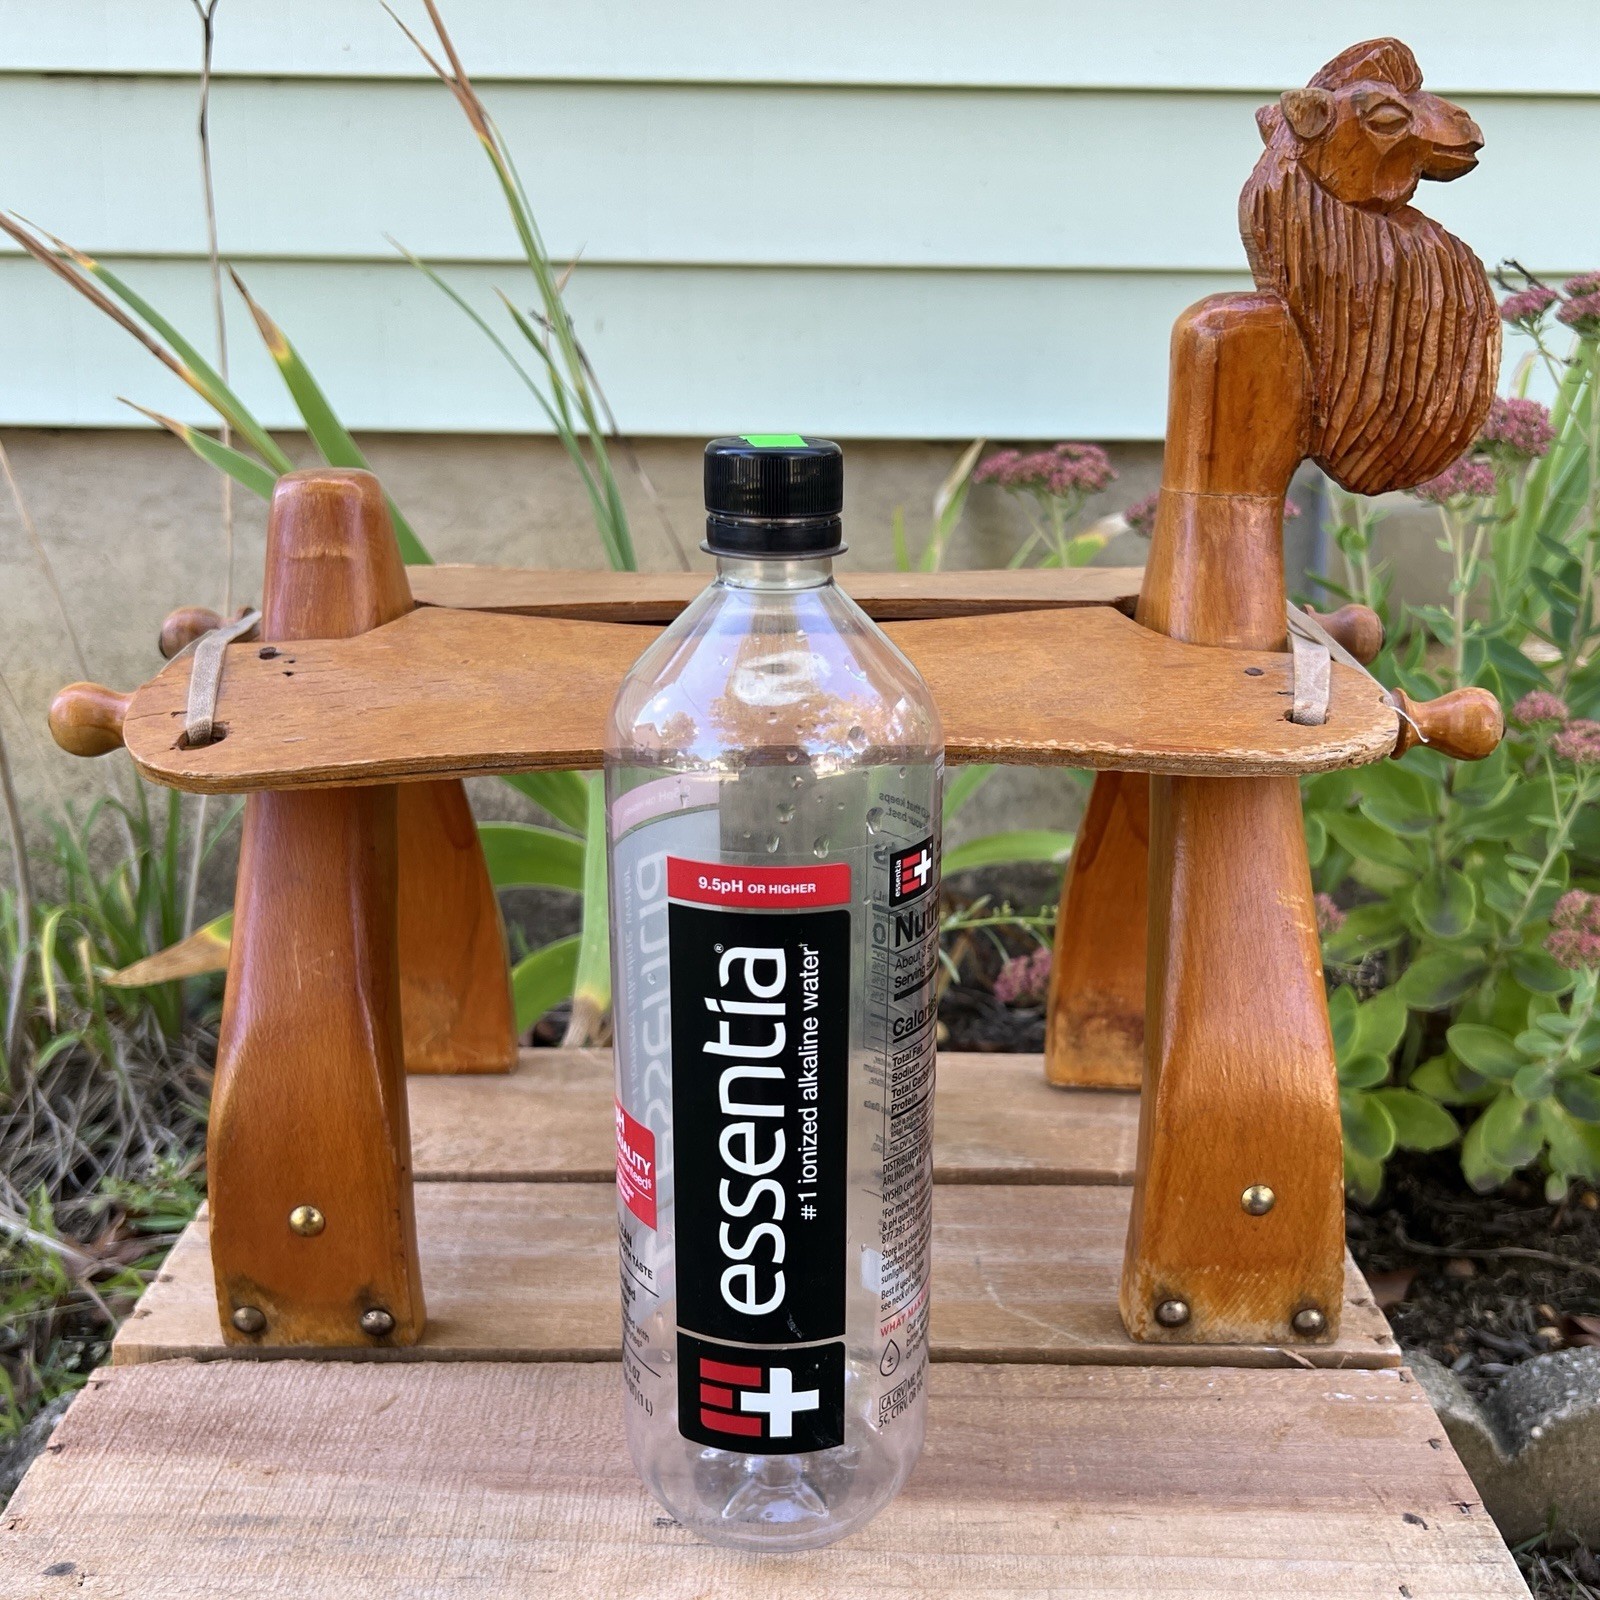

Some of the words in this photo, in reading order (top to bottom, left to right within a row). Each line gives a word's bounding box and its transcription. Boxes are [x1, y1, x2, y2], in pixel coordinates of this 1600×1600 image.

[698, 876, 743, 894] 9.5pH
[747, 883, 766, 894] OR
[768, 883, 816, 894] HIGHER
[894, 950, 921, 972] About
[894, 964, 926, 988] Serving
[798, 1016, 819, 1101] alkaline
[892, 1049, 911, 1067] Total
[912, 1043, 923, 1058] Fat
[892, 1062, 920, 1083] Sodium
[891, 1081, 911, 1099] Total
[891, 1093, 918, 1114] Protein
[797, 1107, 818, 1184] ionized
[883, 1146, 919, 1175] DISTRIBUTED
[882, 1184, 903, 1203] NYSHD
[903, 1178, 915, 1192] Cert
[895, 1198, 910, 1214] more
[882, 1221, 888, 1232] &
[888, 1215, 898, 1230] pH
[881, 1245, 897, 1260] Store
[881, 1252, 905, 1272] odorless
[631, 1254, 654, 1281] TASTE
[881, 1286, 894, 1300] Best
[881, 1300, 892, 1312] see
[880, 1313, 906, 1338] WHAT
[645, 1397, 653, 1417] L)
[881, 1395, 892, 1410] CA
